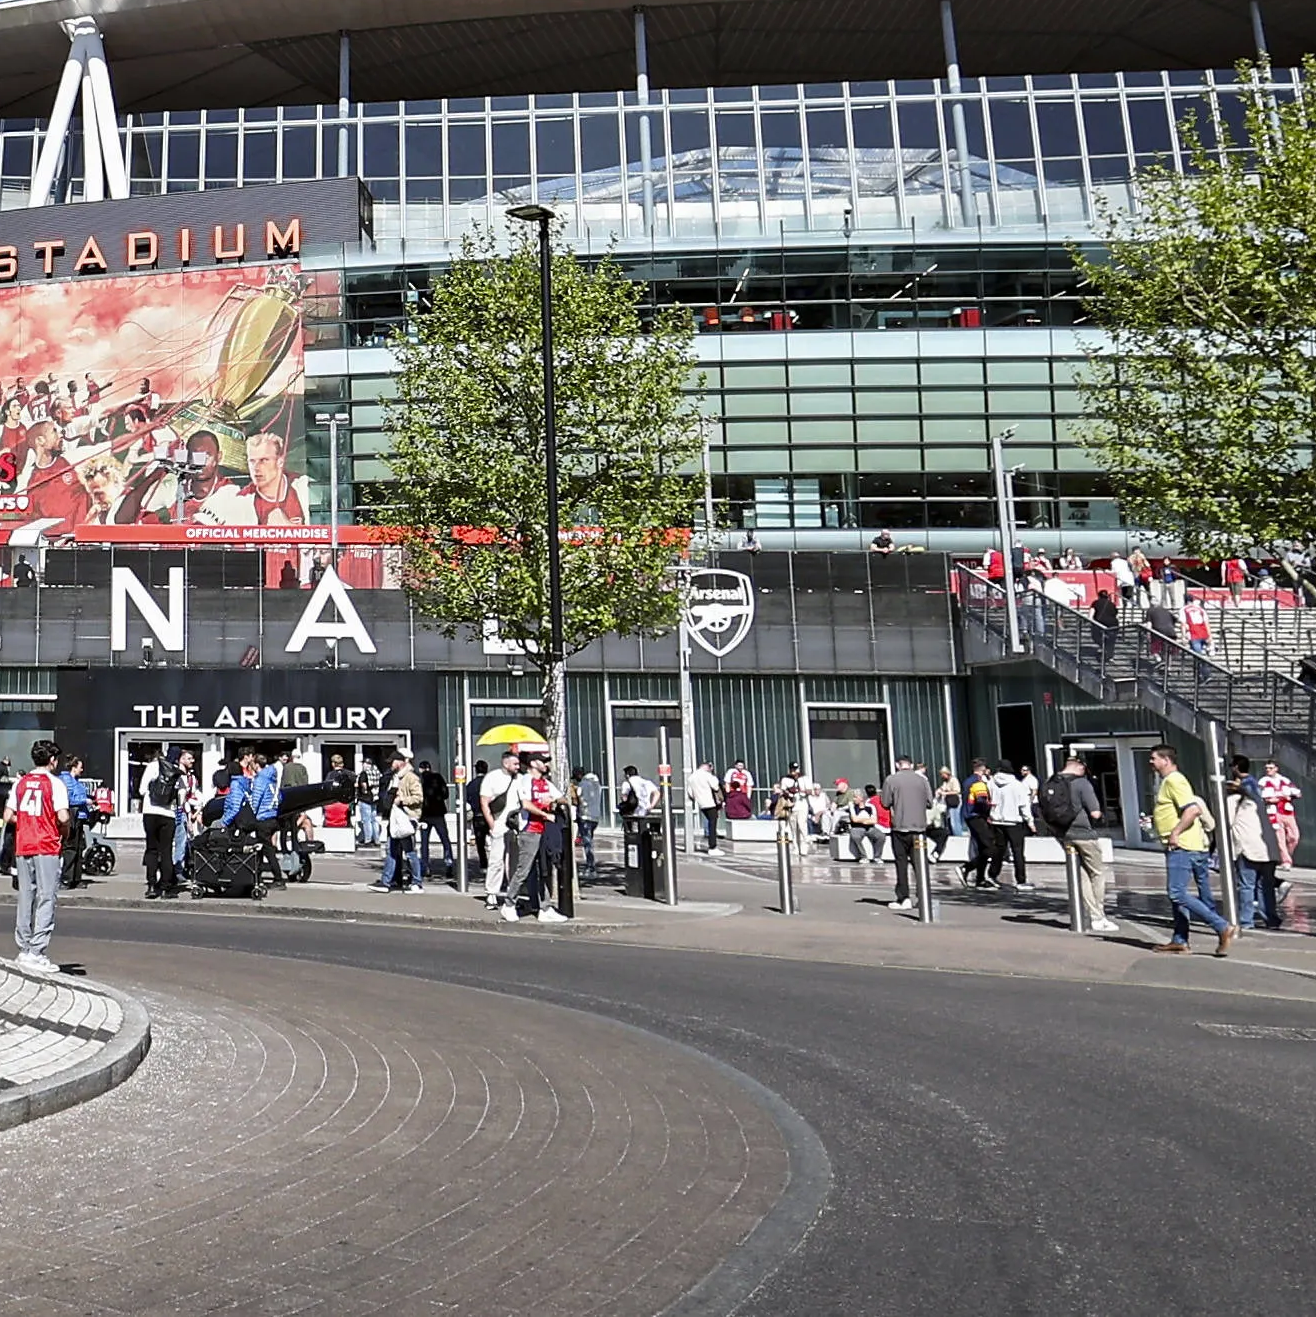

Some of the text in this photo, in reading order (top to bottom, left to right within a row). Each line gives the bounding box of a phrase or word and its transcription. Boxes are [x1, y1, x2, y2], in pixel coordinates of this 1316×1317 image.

[186, 528, 329, 540] OFFICIAL MERCHANDISE
[690, 586, 744, 601] Arsenal
[133, 705, 392, 729] THE ARMOURY
[20, 789, 42, 816] 41
